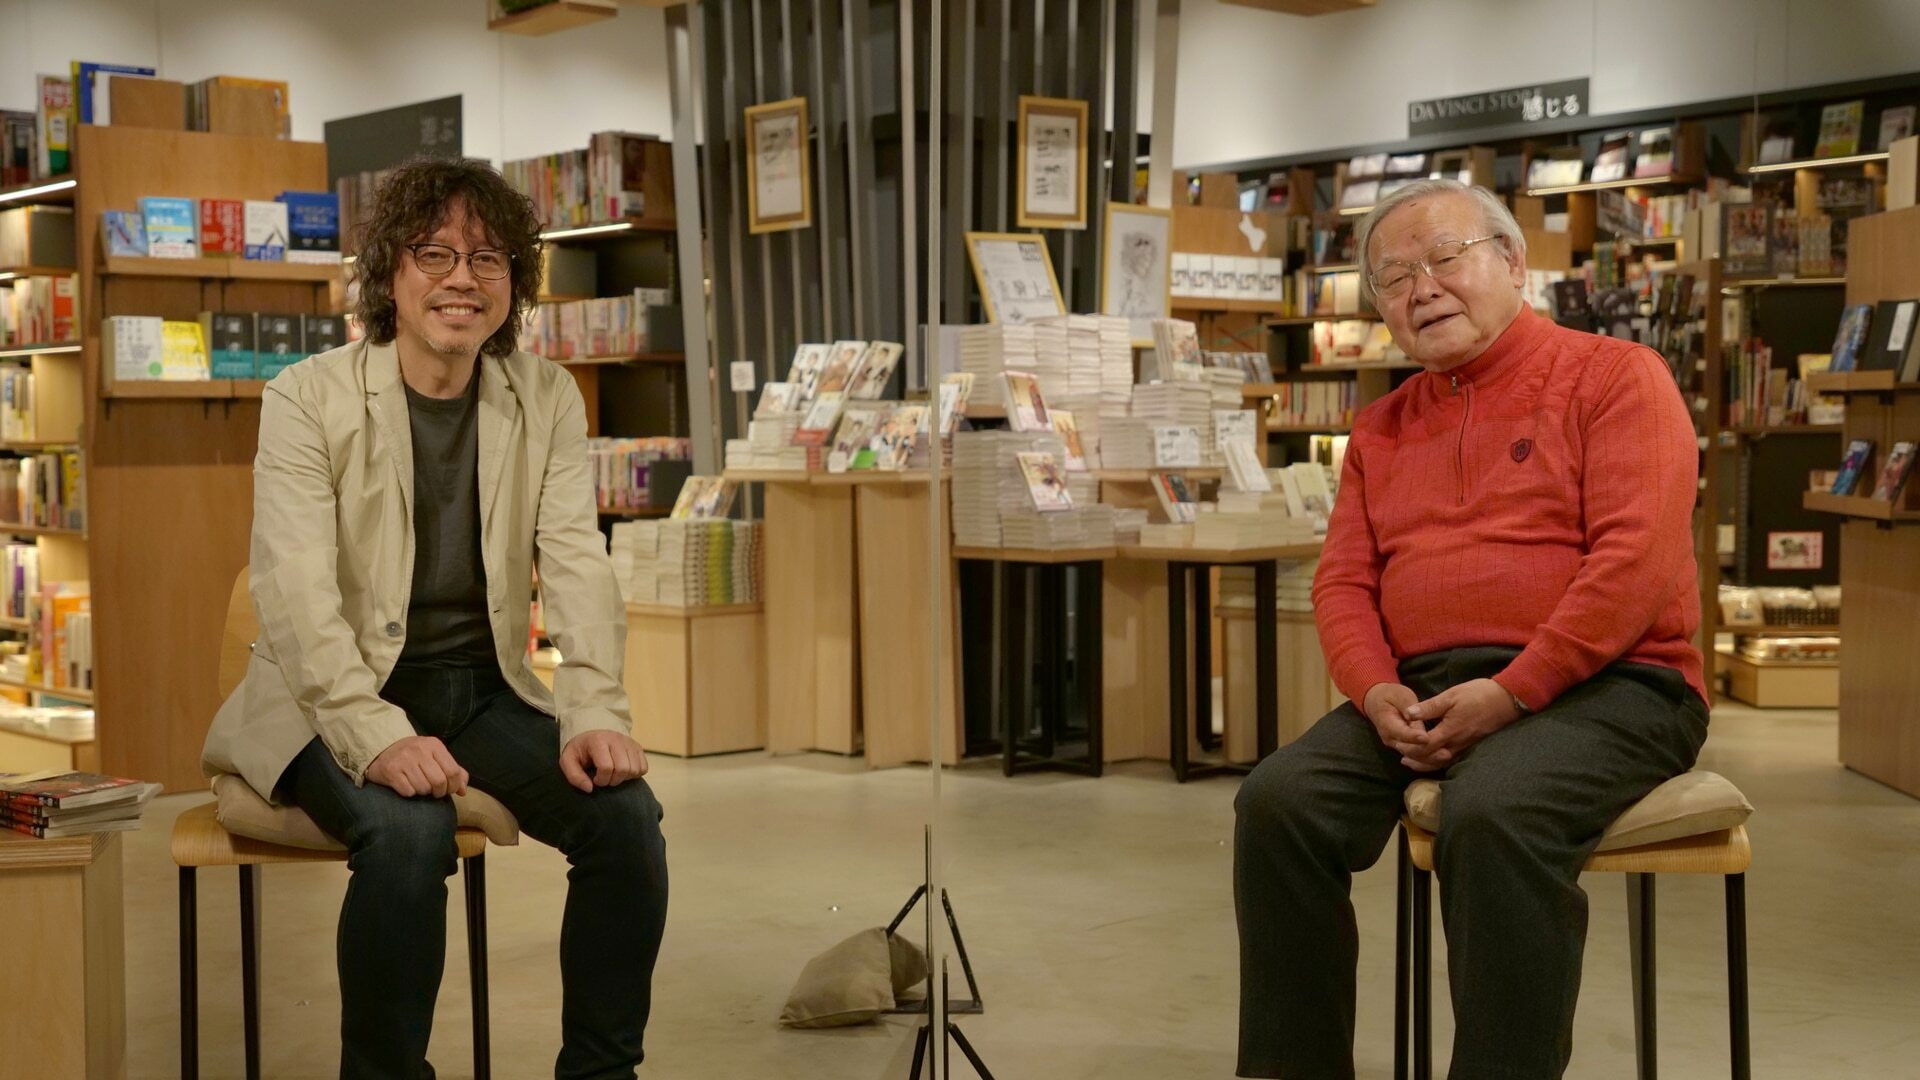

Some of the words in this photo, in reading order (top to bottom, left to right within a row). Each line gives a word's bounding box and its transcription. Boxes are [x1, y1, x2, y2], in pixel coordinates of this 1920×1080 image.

[1410, 102, 1436, 122] DA
[1436, 95, 1485, 117] VINCI
[1521, 94, 1580, 121] 感じる
